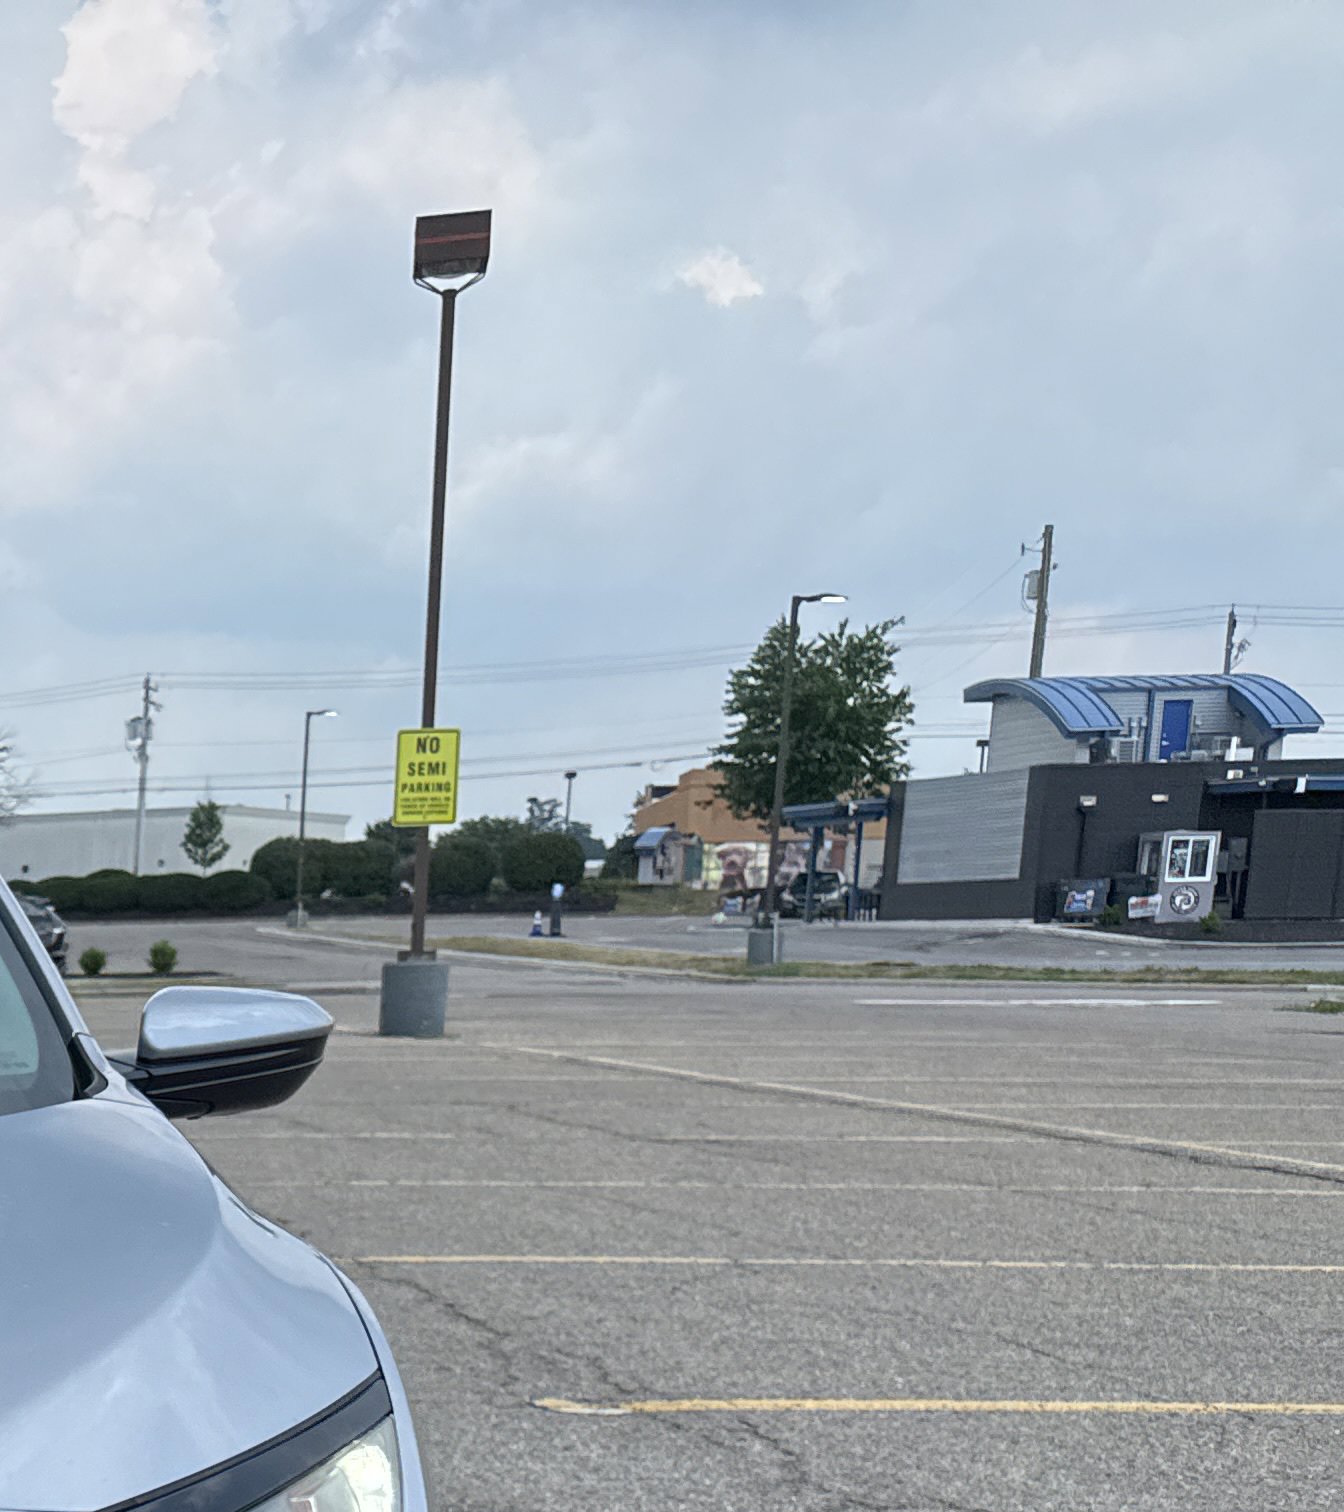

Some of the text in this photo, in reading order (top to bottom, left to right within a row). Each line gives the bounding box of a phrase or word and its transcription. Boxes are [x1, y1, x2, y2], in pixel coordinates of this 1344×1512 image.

[416, 737, 440, 754] NO
[407, 762, 446, 777] SEMI
[401, 782, 451, 793] PARKING
